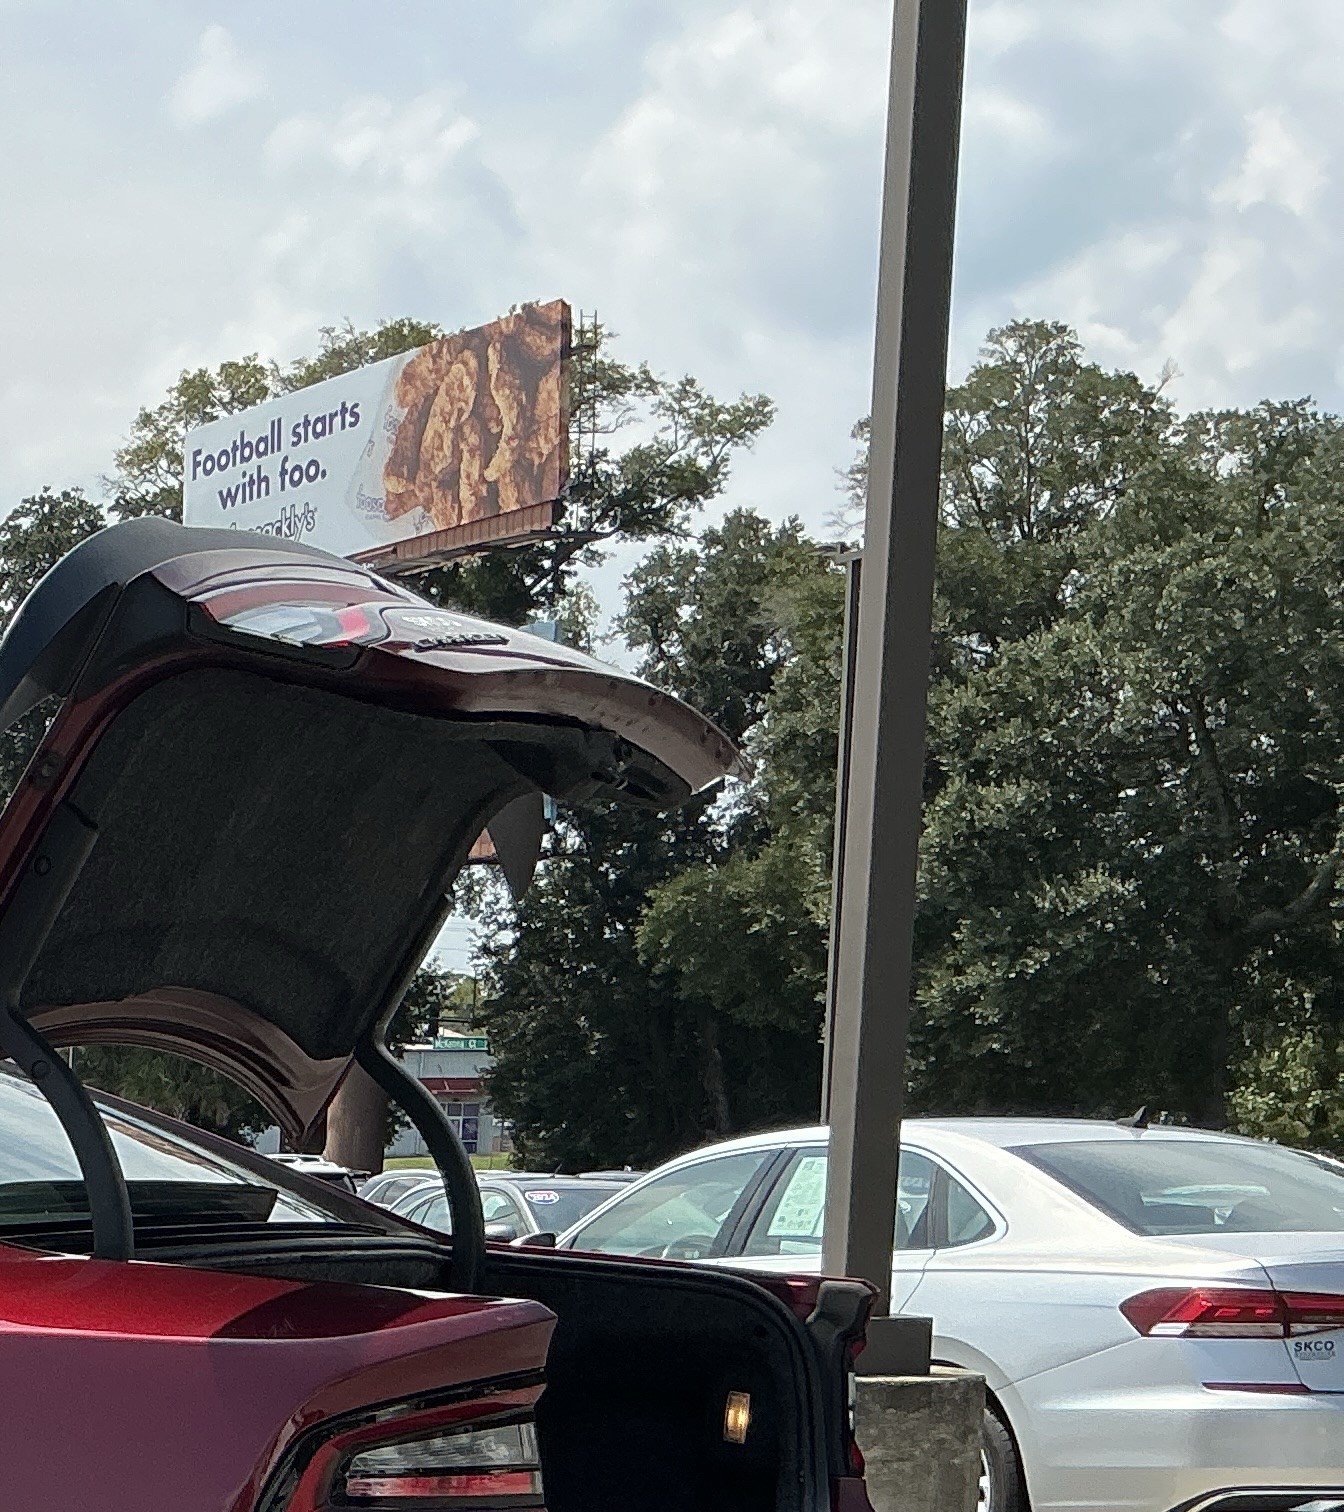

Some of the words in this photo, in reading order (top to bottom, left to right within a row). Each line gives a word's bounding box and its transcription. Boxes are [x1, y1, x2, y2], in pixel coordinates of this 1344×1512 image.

[191, 416, 282, 482] Football
[290, 399, 361, 449] starts
[218, 469, 270, 511] with
[279, 453, 328, 493] foo.
[230, 502, 316, 542] ackly's
[1294, 1340, 1335, 1352] SKCO
